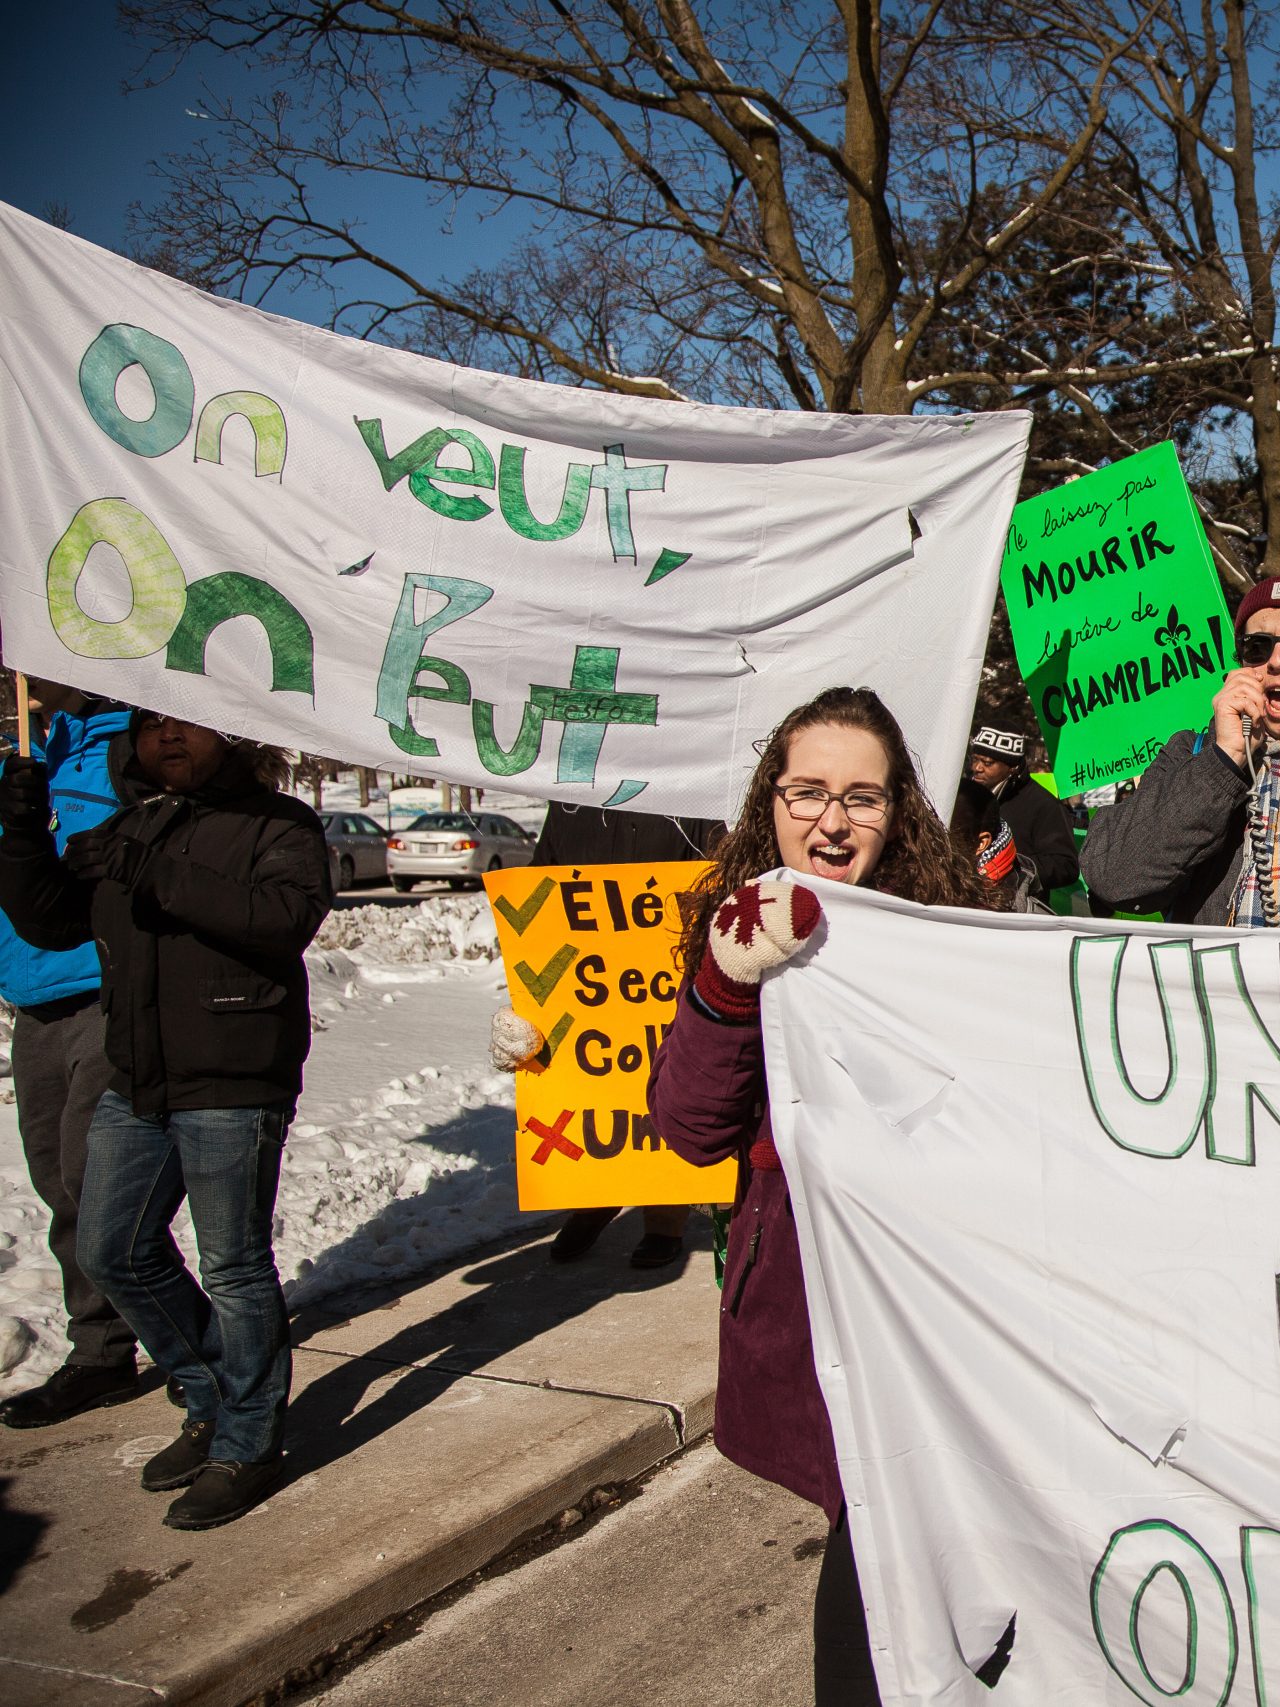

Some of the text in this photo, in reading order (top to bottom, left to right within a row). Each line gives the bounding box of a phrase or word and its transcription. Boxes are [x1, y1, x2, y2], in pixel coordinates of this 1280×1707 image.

[79, 323, 692, 587] On veut,
[1041, 501, 1113, 538] laissez
[1117, 475, 1157, 516] pas
[1021, 520, 1175, 608] MOURIR
[47, 497, 316, 711] On
[1069, 616, 1121, 650] rêve
[1131, 591, 1160, 623] de
[575, 955, 676, 1007] Sec
